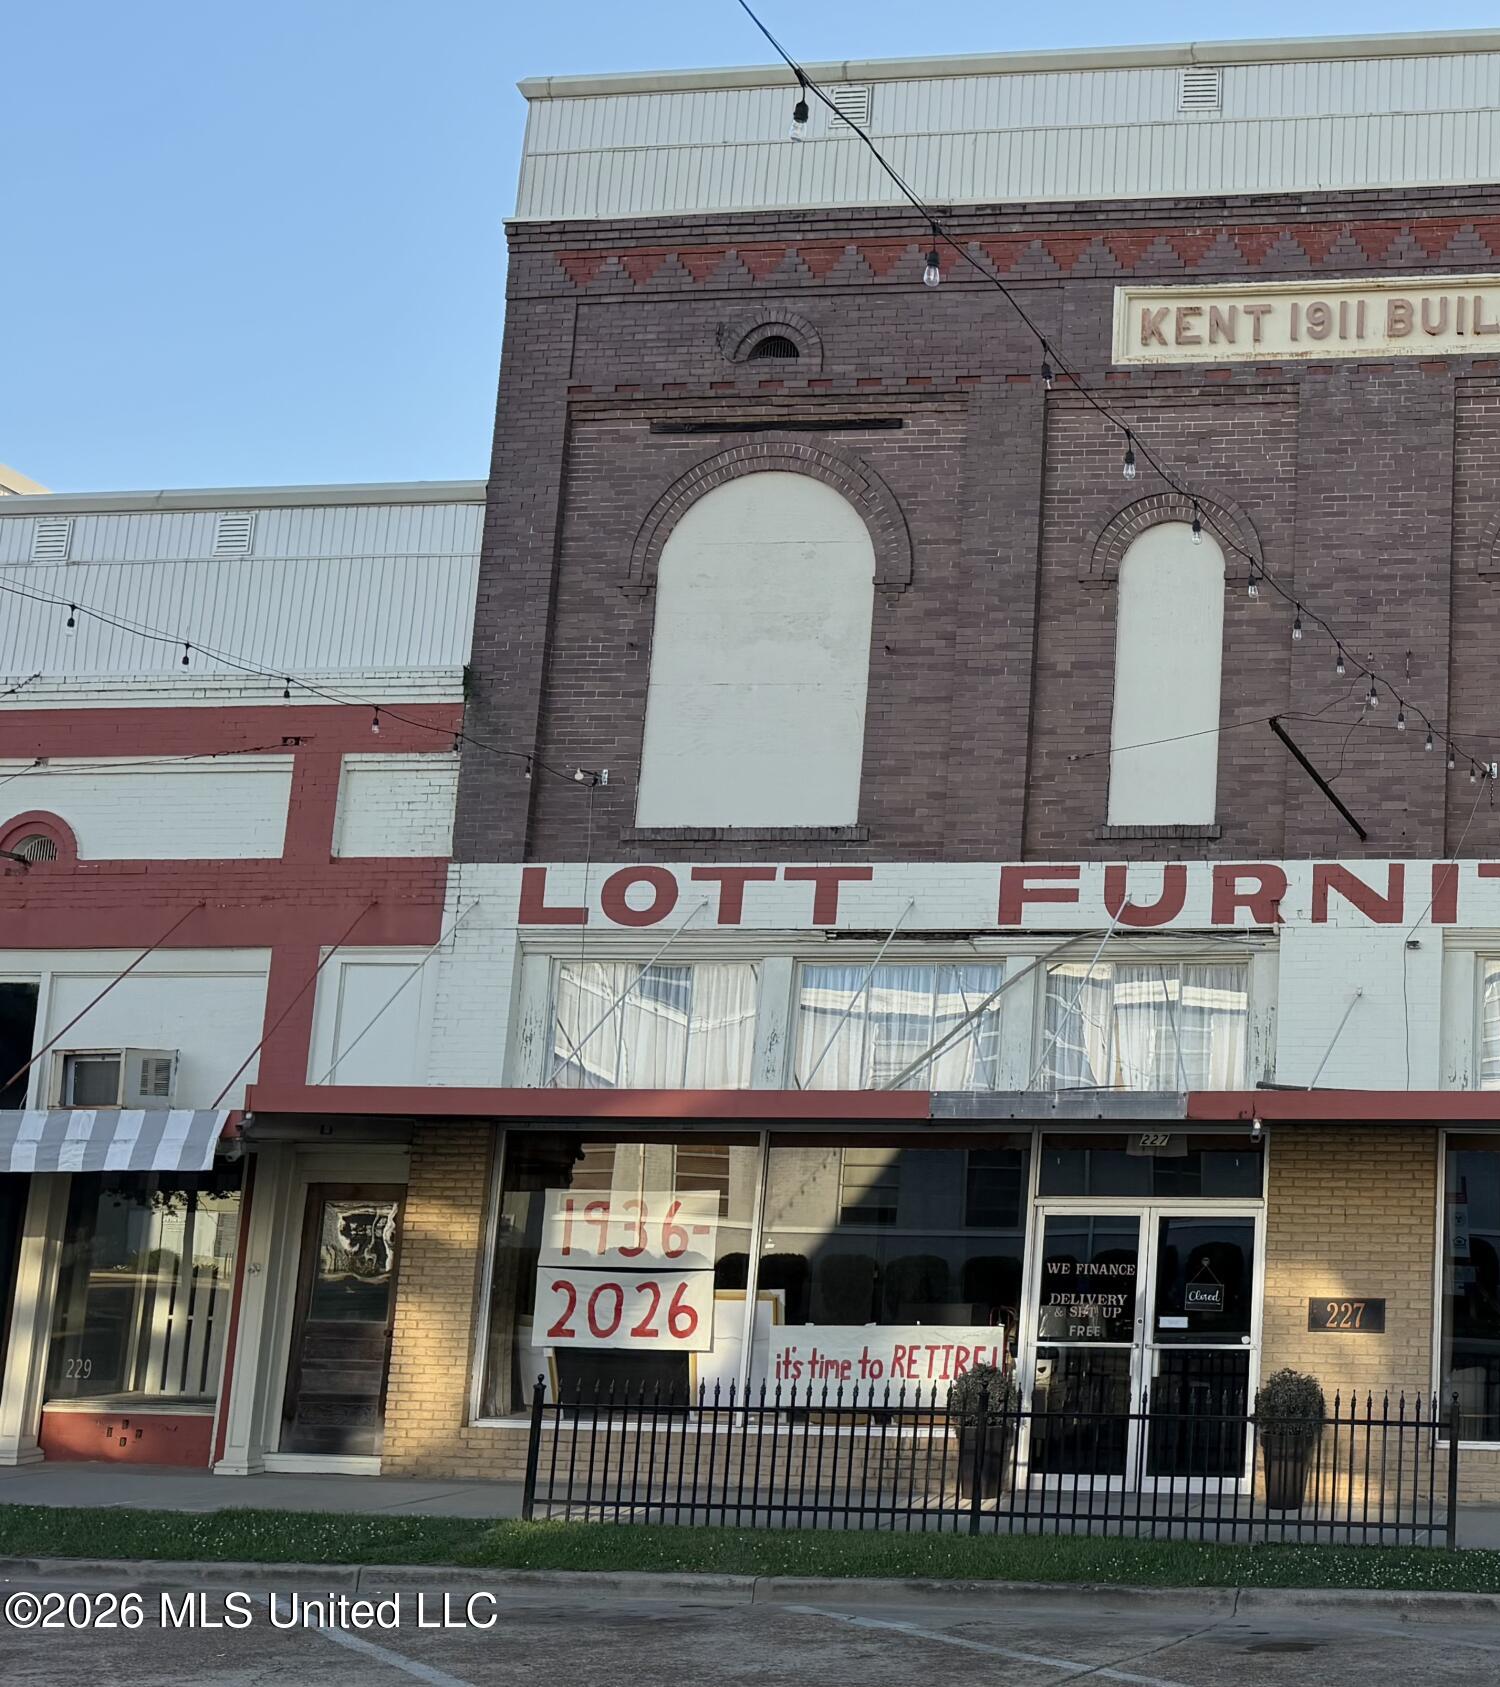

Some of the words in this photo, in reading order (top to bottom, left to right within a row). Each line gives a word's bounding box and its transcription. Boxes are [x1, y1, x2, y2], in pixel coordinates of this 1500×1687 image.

[1140, 303, 1273, 347] KENT
[1289, 300, 1366, 341] 1911
[517, 865, 874, 927] LOTT
[1141, 1134, 1169, 1145] 227
[1047, 1262, 1071, 1274] WE
[1076, 1263, 1136, 1276] FINANCE
[1049, 1293, 1128, 1306] DELIVERY
[1189, 1290, 1221, 1302] Closed
[547, 1280, 699, 1339] 2026
[1054, 1306, 1064, 1318] &
[1069, 1306, 1094, 1318] SET
[1102, 1307, 1122, 1318] UP
[1326, 1302, 1366, 1329] 227
[1069, 1325, 1101, 1337] FREE
[66, 1358, 92, 1379] 229
[776, 1346, 804, 1380] it's
[808, 1347, 852, 1380] time
[858, 1346, 883, 1380] to
